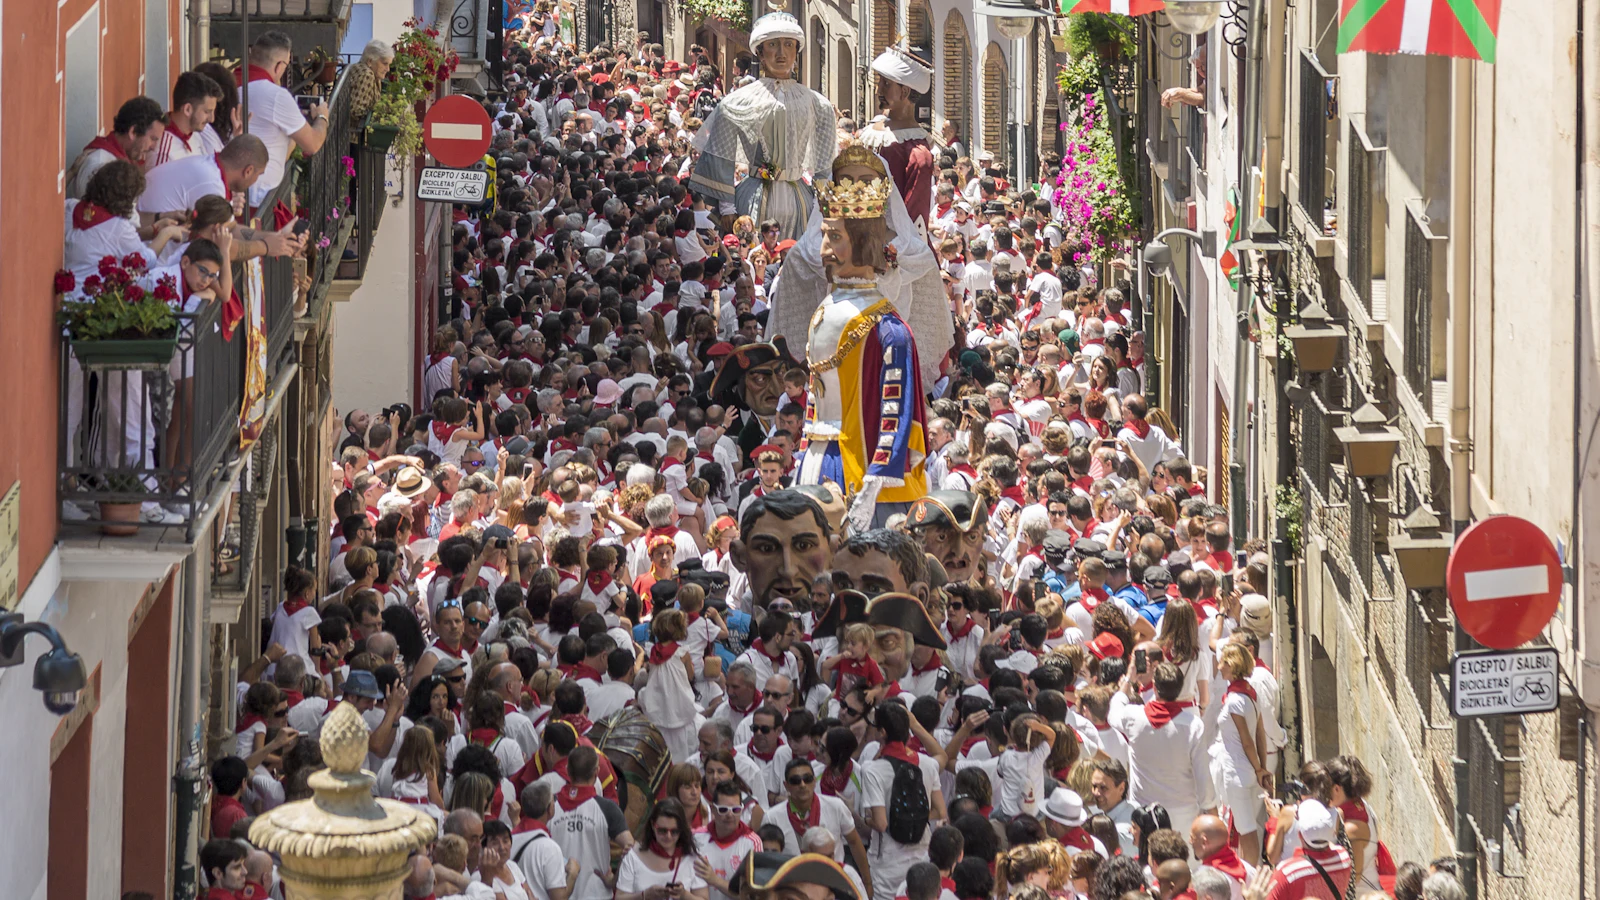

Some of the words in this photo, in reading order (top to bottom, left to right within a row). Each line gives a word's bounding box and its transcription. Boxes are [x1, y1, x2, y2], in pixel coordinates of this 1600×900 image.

[425, 170, 455, 179] EXCEPTO
[422, 180, 455, 188] BICICLETAS
[1461, 658, 1507, 675] EXCEPTO
[1460, 677, 1510, 691] BICICLETAS
[1460, 695, 1508, 709] BIZIKLETAK
[567, 820, 583, 832] 30
